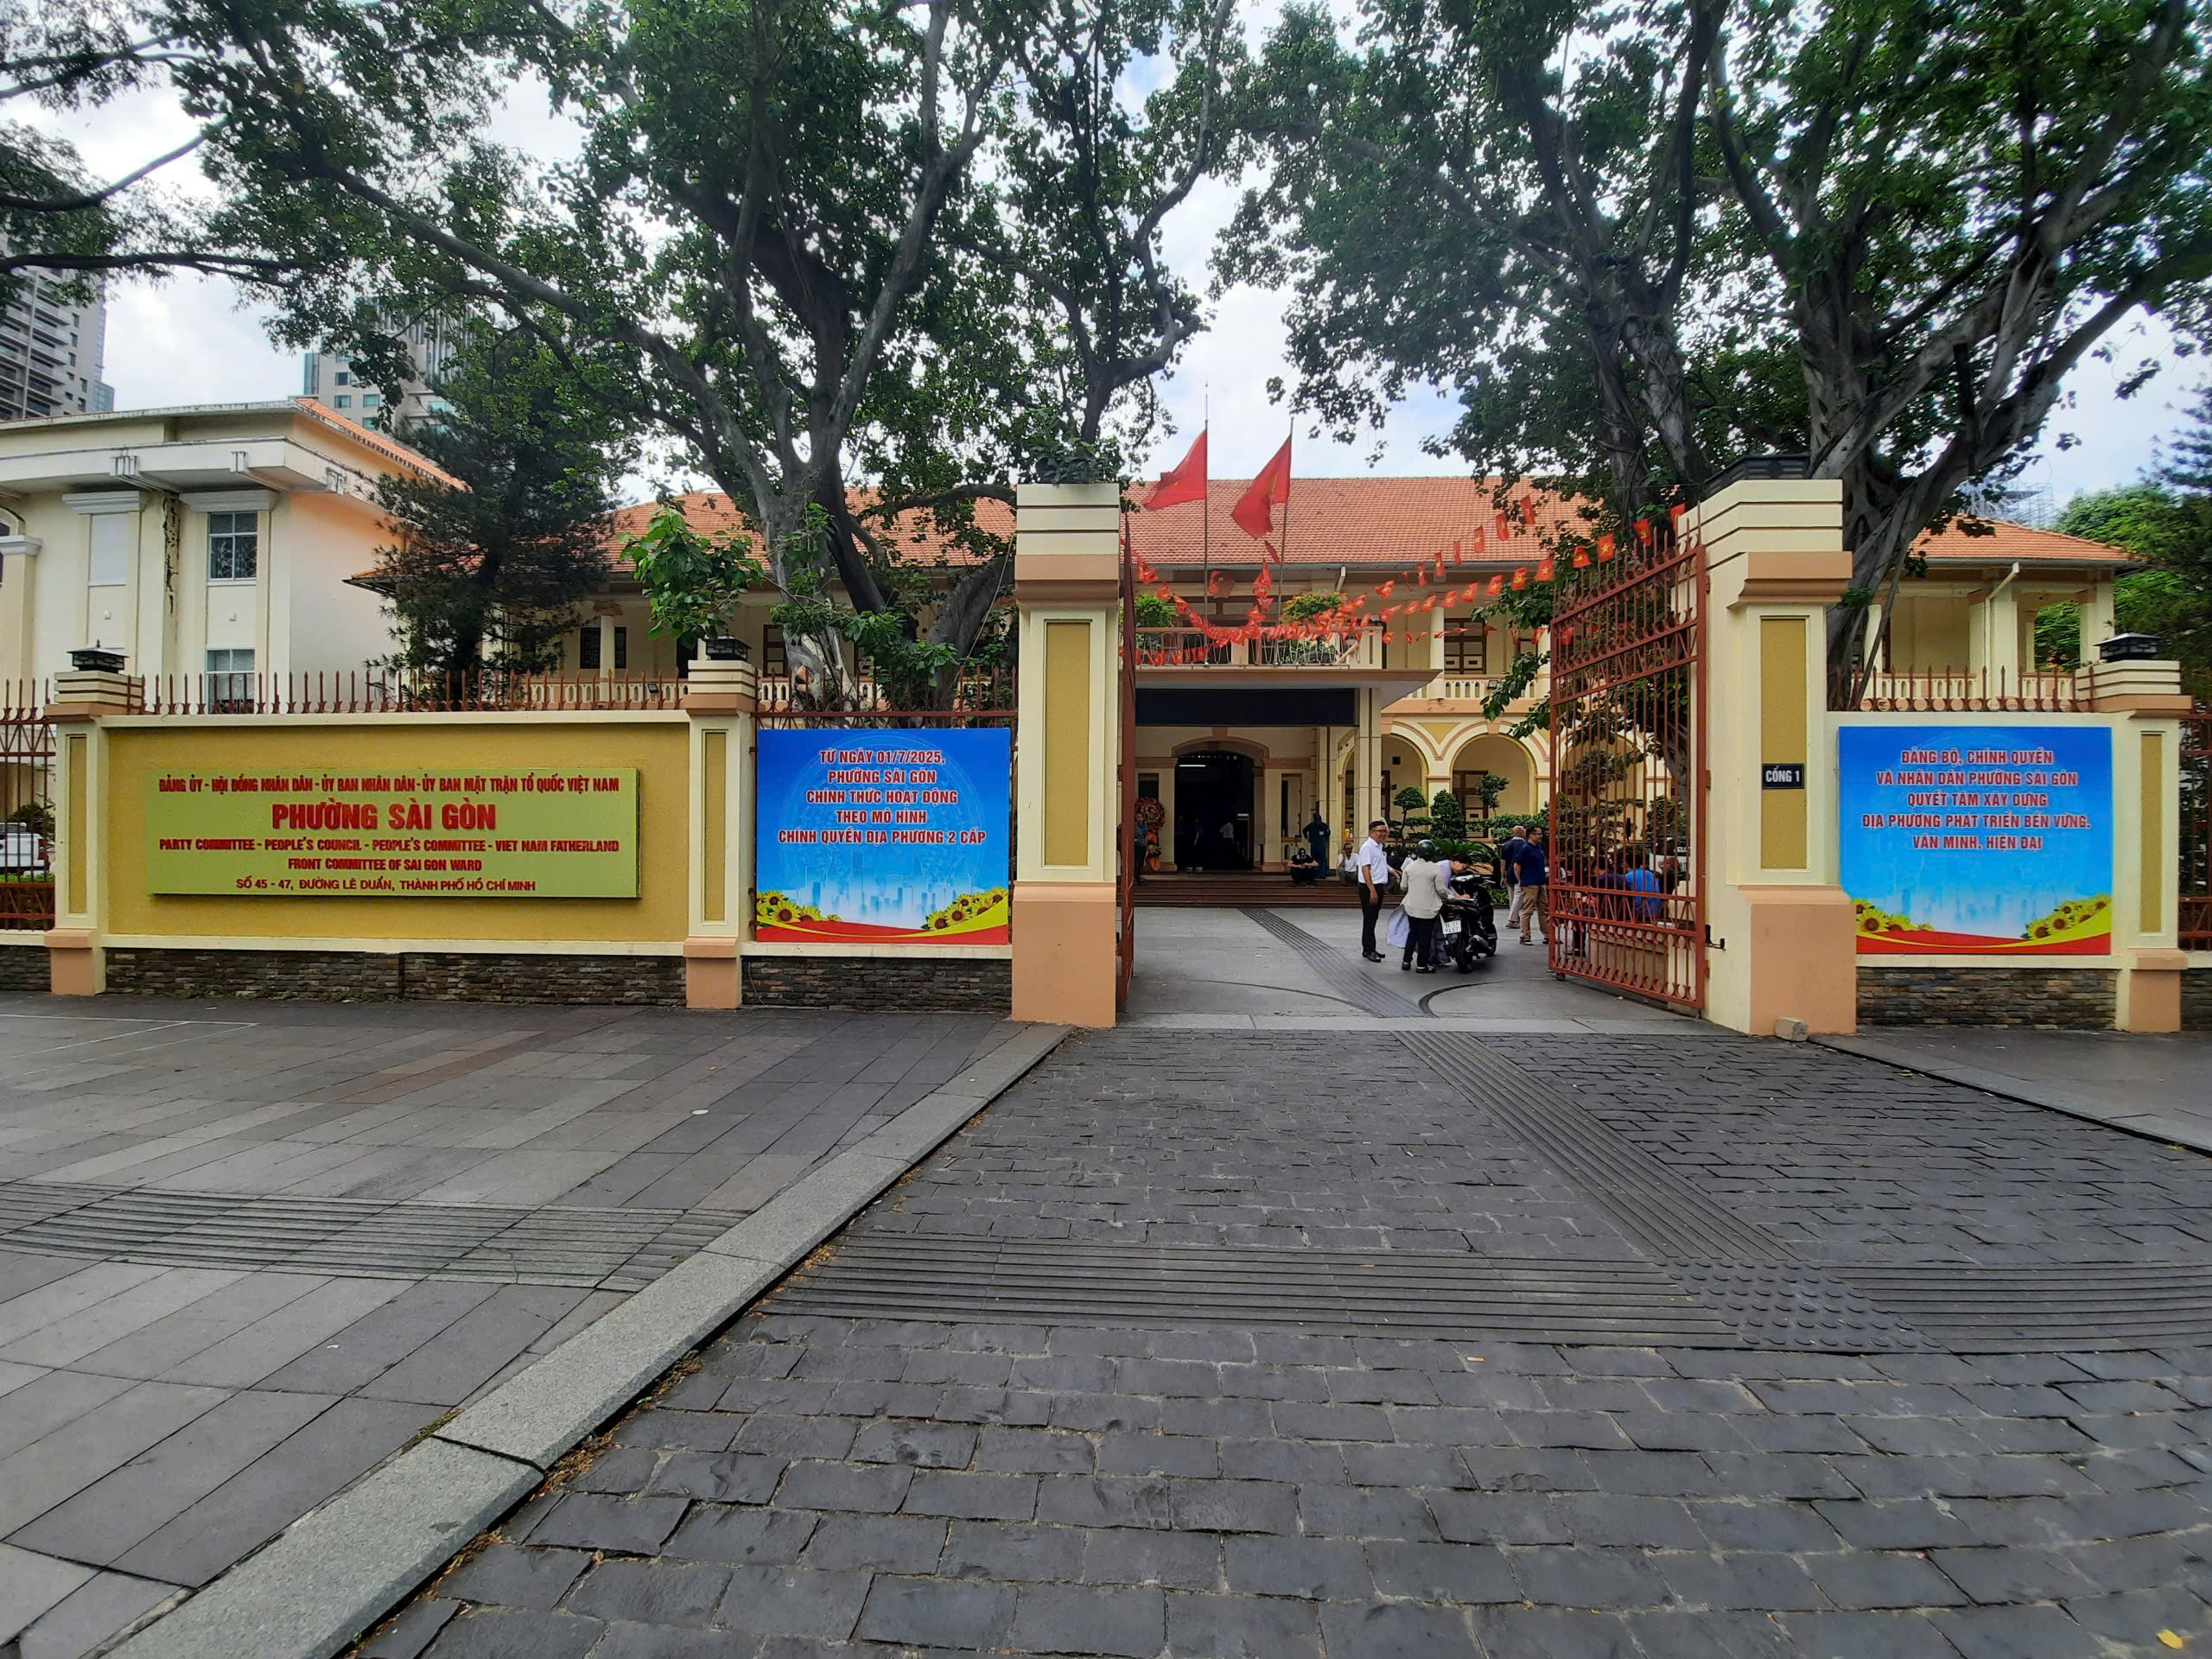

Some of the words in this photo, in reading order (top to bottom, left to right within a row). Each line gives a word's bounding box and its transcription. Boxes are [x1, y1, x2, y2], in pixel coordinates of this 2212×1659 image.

[820, 748, 836, 763] TỪ
[839, 749, 873, 764] NGÀY
[877, 749, 946, 764] 01/7/2025,
[828, 768, 880, 784] PHƯỜNG
[883, 769, 906, 784] SÀI
[909, 768, 937, 784] GÒN
[1765, 766, 1792, 782] CỔNG
[1795, 771, 1800, 781] 1
[159, 774, 187, 792] ĐẢNG
[189, 774, 203, 791] ỦY
[212, 774, 228, 794] HỘI
[261, 776, 289, 792] NHÂN
[293, 775, 313, 792] DÂN
[321, 774, 334, 791] ỦY
[338, 777, 359, 792] BAN
[362, 775, 391, 792] NHÂN
[394, 775, 416, 792] DÂN
[423, 774, 435, 791] ỦY
[440, 776, 460, 791] BAN
[537, 773, 563, 792] QUỐC
[568, 774, 589, 794] VIỆT
[593, 776, 619, 792] NAM
[806, 789, 845, 804] CHÍNH
[849, 788, 881, 804] THỨC
[886, 790, 918, 805] HOẠT
[922, 787, 957, 805] ĐỘNG
[272, 797, 378, 830] PHƯỜNG
[388, 797, 432, 830] SÀI
[442, 797, 496, 830] GÒN
[836, 810, 868, 823] THEO
[871, 809, 892, 823] MÔ
[896, 809, 927, 823] HÌNH
[779, 829, 817, 843] CHÍNH
[866, 830, 887, 844] ĐỊA
[892, 829, 944, 844] PHƯƠNG
[948, 830, 957, 844] 2
[960, 828, 986, 844] CẤP
[160, 837, 192, 850] PARTY
[196, 837, 255, 850] COMMITTEE
[265, 836, 314, 850] PEOPLE'S
[318, 837, 361, 851] COUNCIL
[372, 837, 420, 851] PEOPLE'S
[424, 838, 486, 852] COMMITTEE
[495, 839, 518, 852] VIET
[522, 839, 547, 852] NAM
[550, 839, 619, 853] FATHERLAND
[289, 857, 321, 869] FRONT
[326, 857, 385, 871] COMMITTEE
[389, 858, 402, 871] OF
[404, 857, 421, 870] SAI
[424, 857, 447, 871] GON
[450, 858, 482, 871] WARD
[237, 875, 252, 888] SỐ
[255, 878, 267, 888] 45
[278, 879, 294, 890] 47,
[299, 877, 340, 890] ĐƯỜNG
[343, 878, 357, 890] LÊ
[401, 879, 437, 890] THÀNH
[441, 877, 464, 890] PHỐ
[486, 879, 505, 890] CHÍ
[508, 880, 535, 891] MINH
